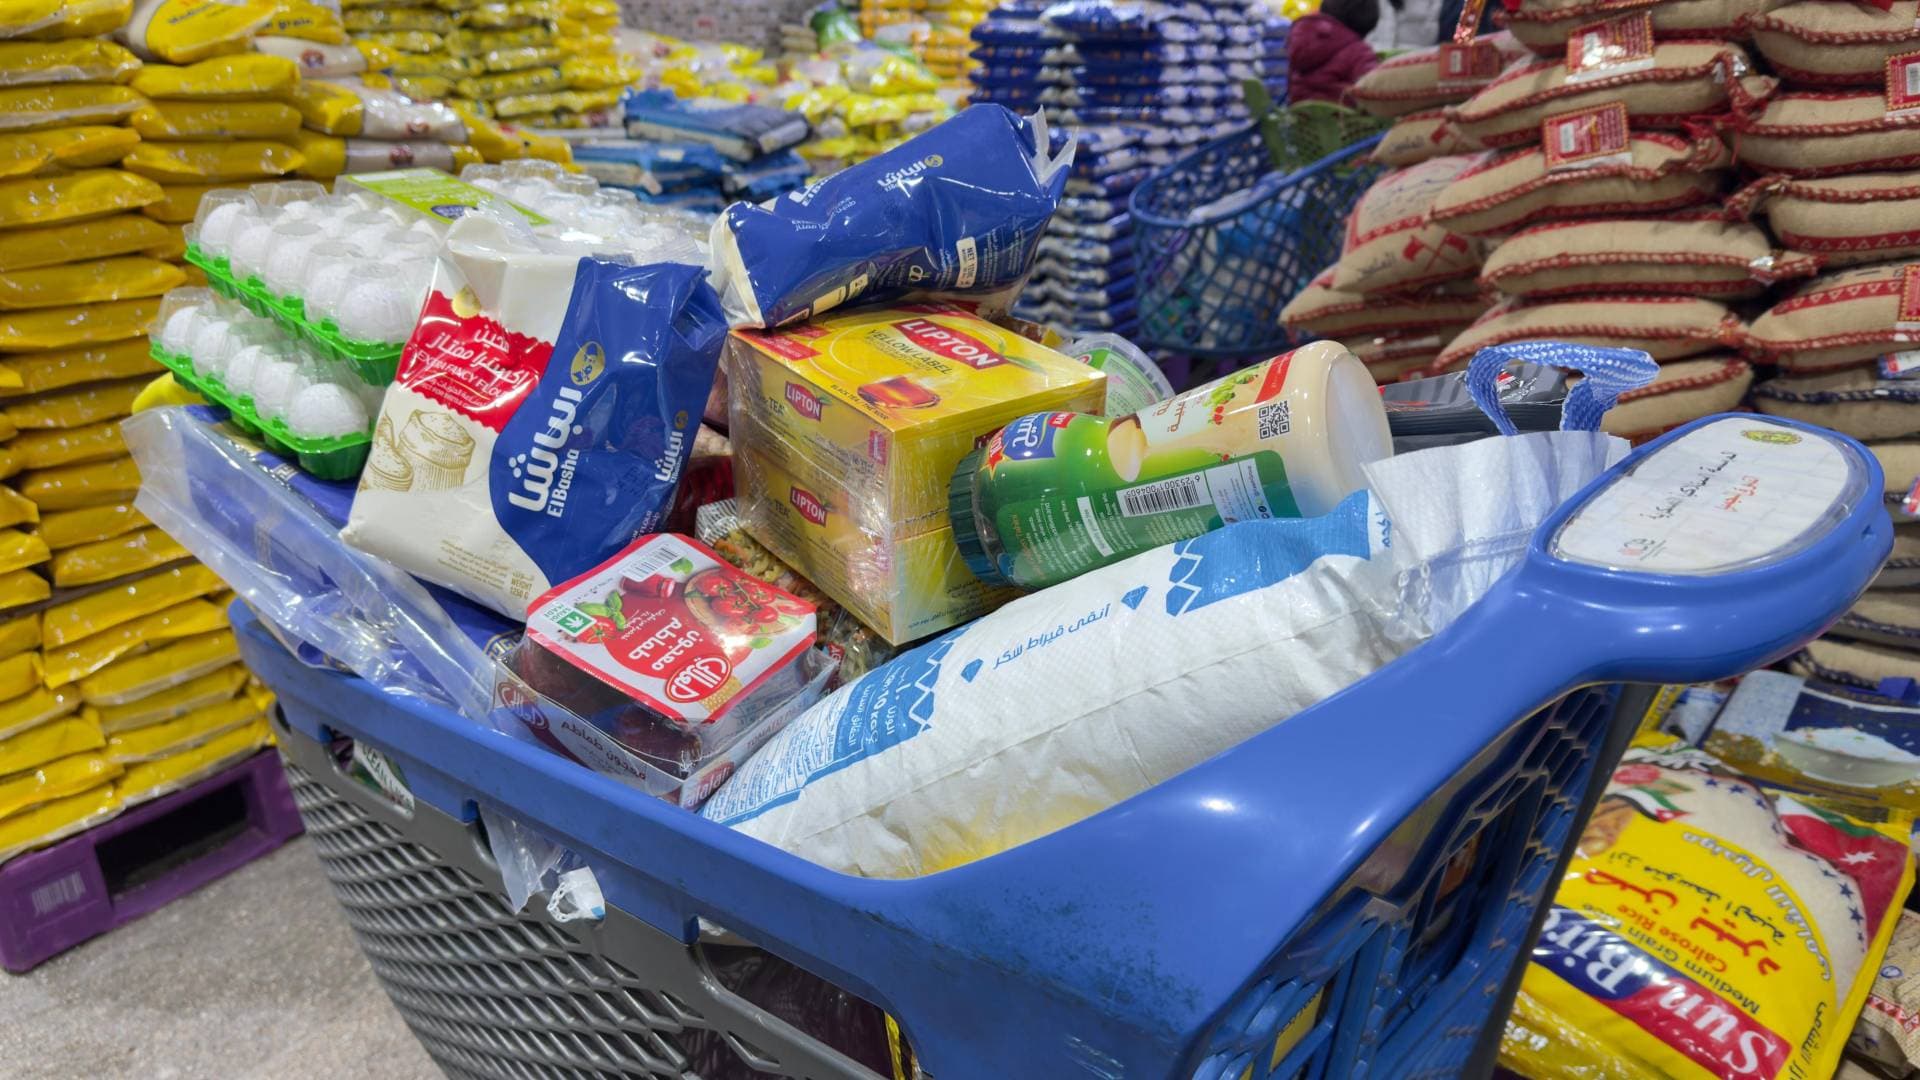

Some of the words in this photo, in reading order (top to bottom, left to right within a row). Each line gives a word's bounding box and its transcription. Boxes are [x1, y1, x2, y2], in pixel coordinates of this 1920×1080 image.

[425, 331, 474, 361] ممتاز
[867, 329, 915, 356] YELLOW
[913, 352, 953, 375] LABEL
[901, 320, 1000, 367] LIPTON
[446, 361, 478, 383] FANCY
[786, 384, 820, 417] LIPTON
[508, 386, 583, 512] الباشا
[655, 431, 684, 482] الباشا
[547, 448, 580, 518] ElBasha
[791, 490, 826, 524] LIPTON
[510, 586, 524, 599] 1250
[511, 577, 533, 592] WEIGHT
[628, 617, 683, 660] طماطم
[1027, 625, 1064, 651] قيراط
[1068, 603, 1111, 633] أنقى
[651, 630, 701, 672] معجون
[561, 720, 603, 751] طماطم
[848, 715, 863, 746] الحقائق
[1682, 830, 1774, 882] مونديال
[1607, 851, 1637, 869] أرز
[1640, 864, 1721, 904] متوسط
[1723, 897, 1787, 945] الحبة
[1616, 904, 1657, 931] Rice
[1583, 868, 1679, 916] صن
[1690, 905, 1782, 977] بيرد
[1626, 928, 1679, 966] Grain
[1661, 925, 1727, 973] Calrose
[1684, 960, 1762, 1016] Medium
[1658, 981, 1778, 1074] Sun
